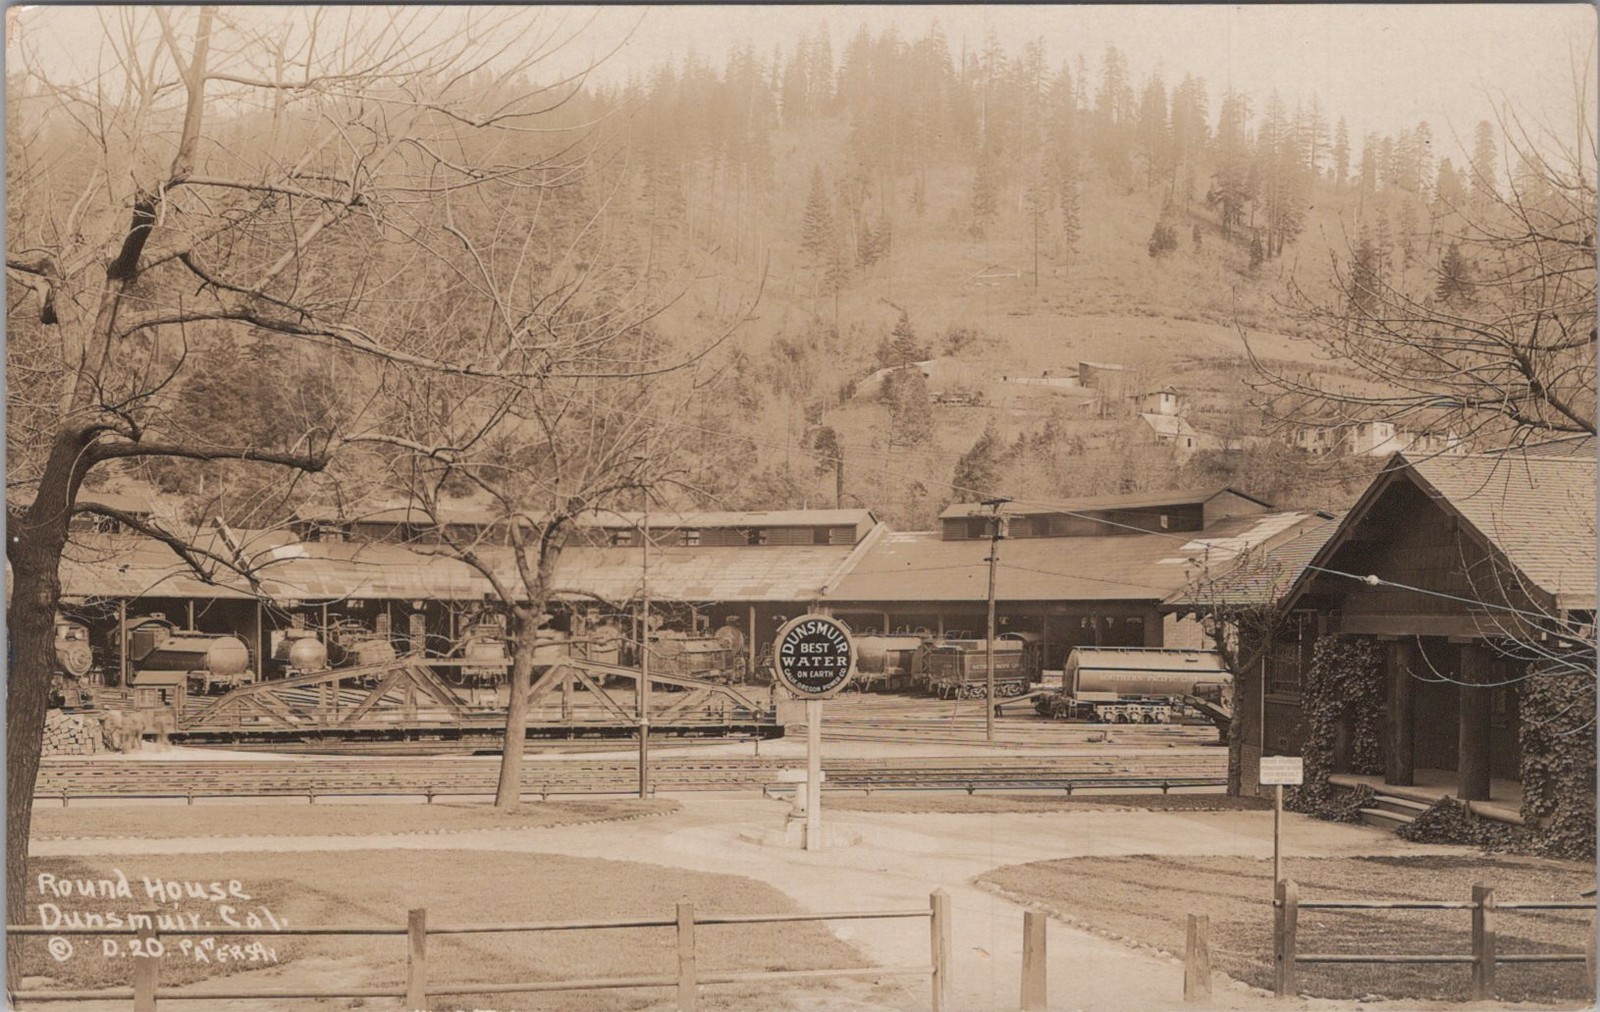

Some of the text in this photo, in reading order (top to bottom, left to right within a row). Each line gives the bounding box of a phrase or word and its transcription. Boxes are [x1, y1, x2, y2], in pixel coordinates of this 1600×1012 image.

[782, 621, 848, 654] DUNSMUIR
[800, 643, 829, 653] BEST
[781, 656, 847, 667] WATER
[797, 670, 834, 678] ON EARTH
